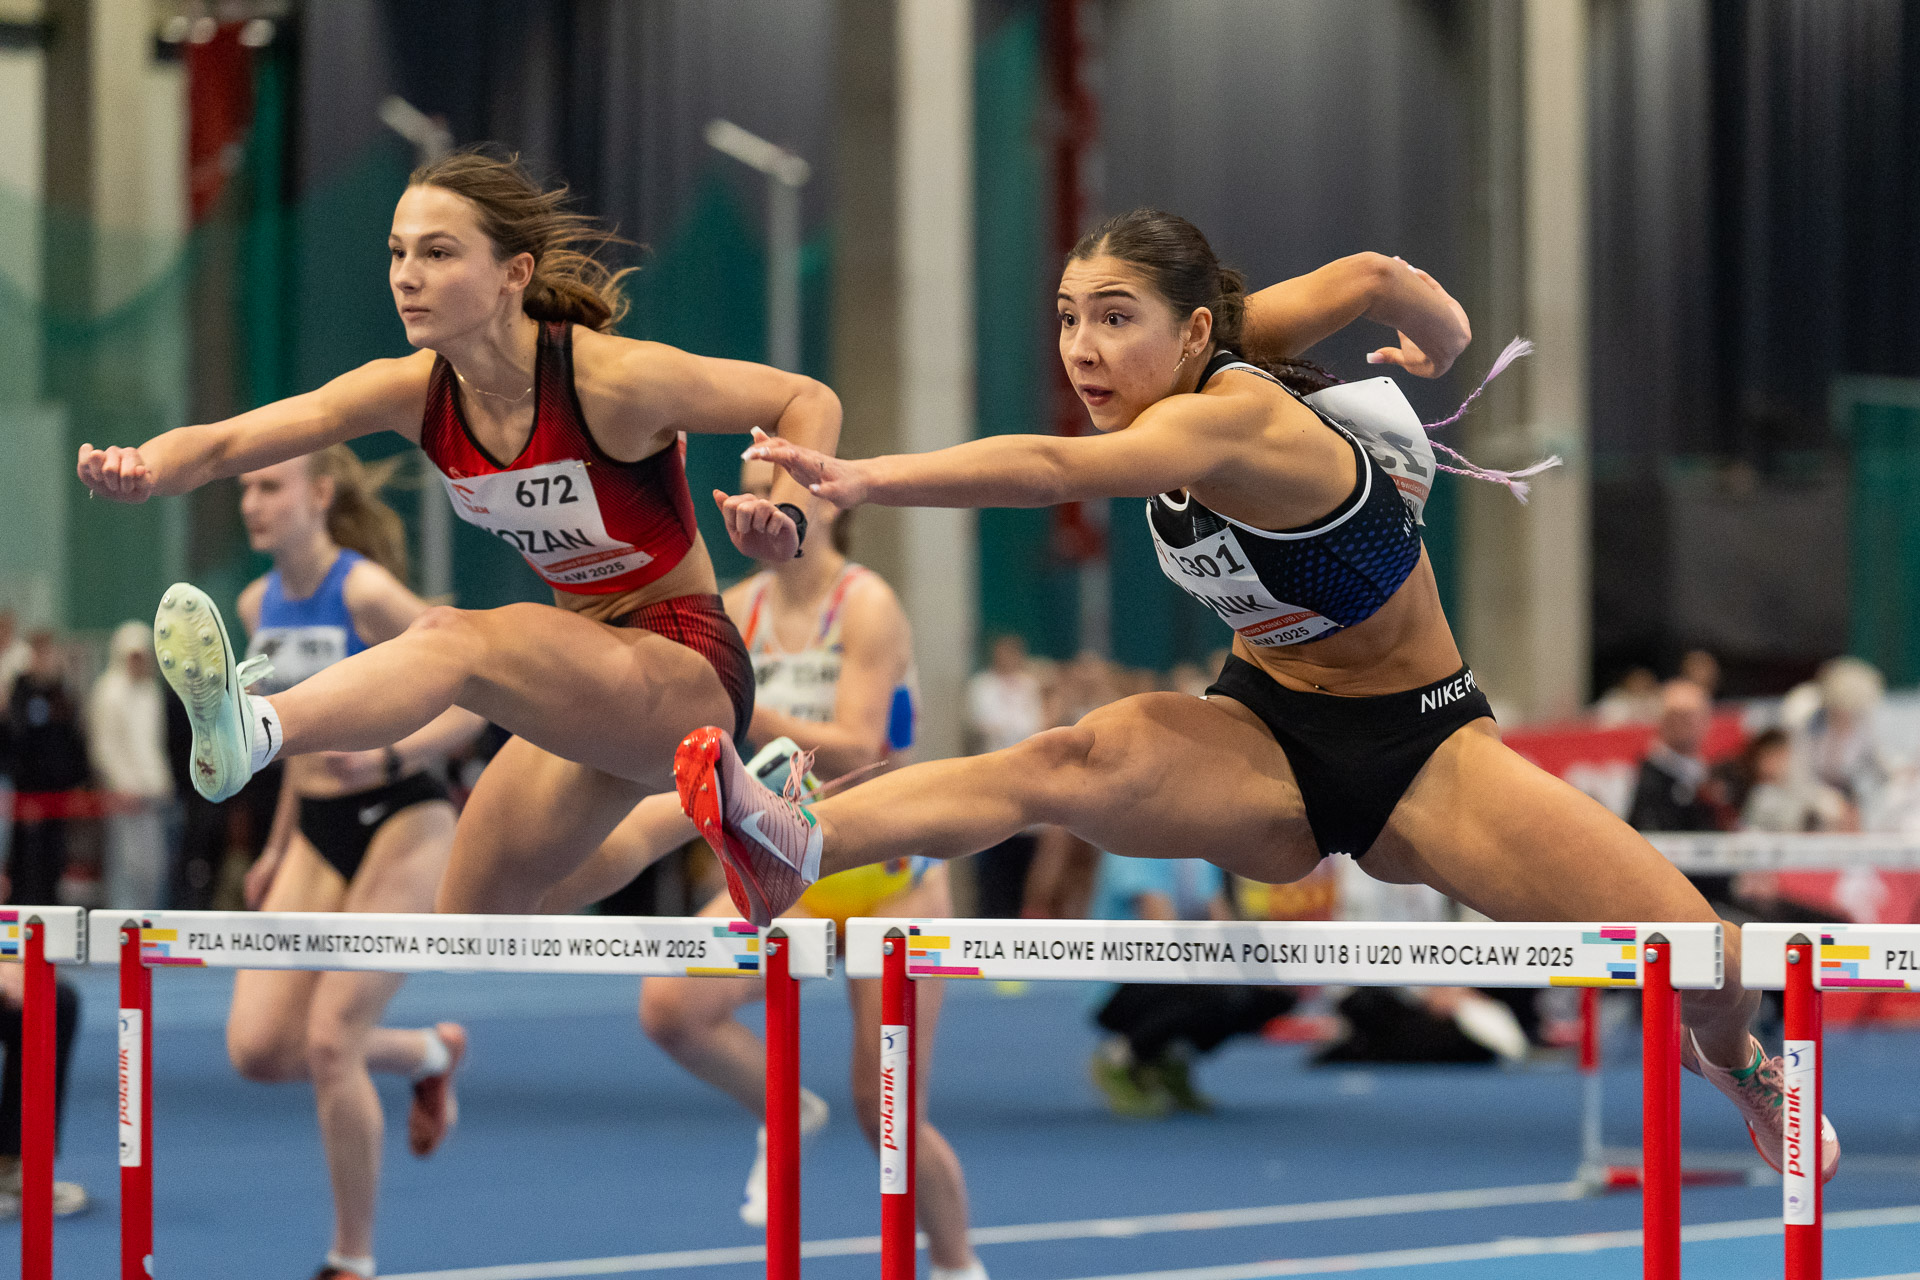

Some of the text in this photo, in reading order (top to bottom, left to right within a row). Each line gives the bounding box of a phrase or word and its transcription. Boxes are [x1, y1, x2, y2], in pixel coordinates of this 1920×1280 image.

[515, 474, 579, 507] 672
[487, 527, 595, 553] OZAN
[589, 562, 625, 577] 2025
[1169, 543, 1245, 578] 1301
[1275, 626, 1310, 643] 2025
[1421, 678, 1466, 714] NIKE
[188, 933, 223, 950] PZLA
[231, 933, 301, 951] HALOWE
[307, 934, 419, 954] MISTRZOSTWA
[427, 937, 481, 955] POLSKI
[487, 938, 516, 956] U18
[531, 939, 561, 957] U20
[567, 939, 661, 958] WROCŁAW
[666, 940, 707, 959] 2025
[963, 940, 1005, 960] PZLA
[1013, 940, 1095, 961] HALOWE
[1101, 942, 1237, 963] MISTRZOSTWA
[1242, 943, 1307, 964] POLSKI
[1314, 945, 1349, 964] U18
[1367, 945, 1402, 965] U20
[1409, 945, 1520, 966] WROCŁAW
[1526, 946, 1574, 966] 2025
[1886, 950, 1920, 970] PZL
[881, 1066, 899, 1151] polanik
[1785, 1085, 1806, 1178] polanik
